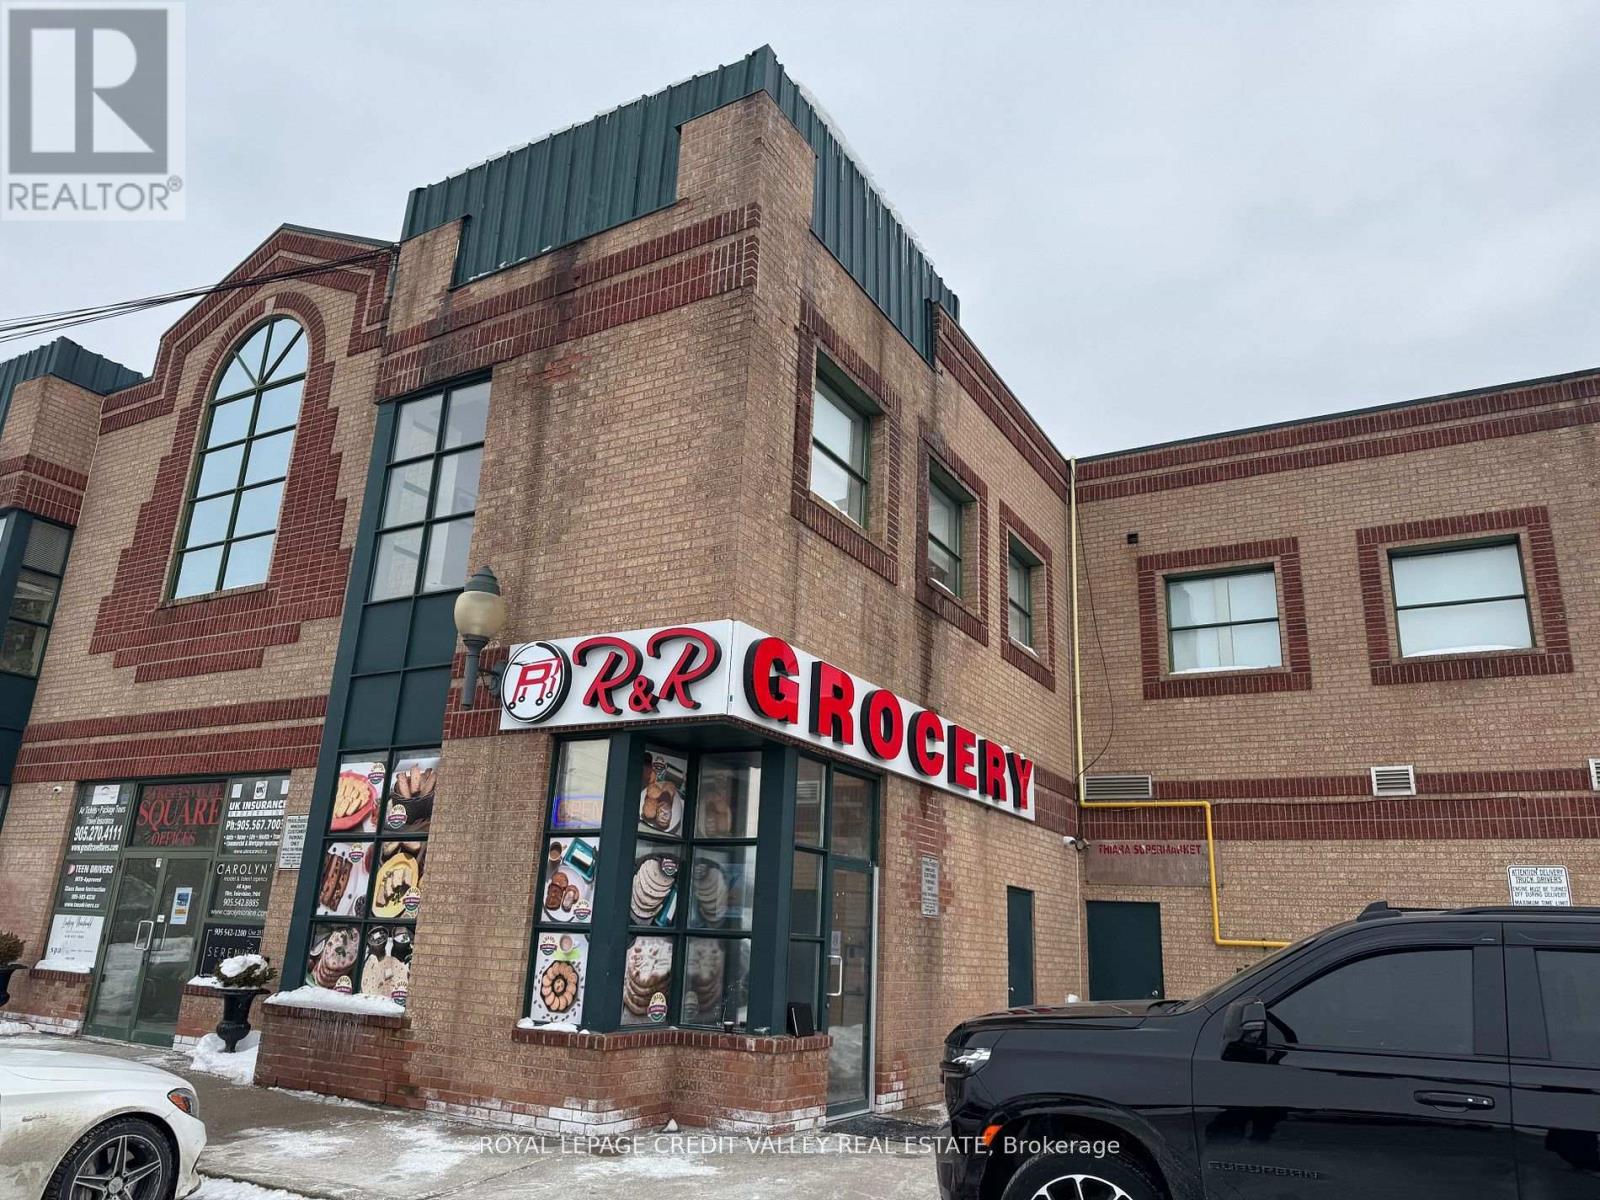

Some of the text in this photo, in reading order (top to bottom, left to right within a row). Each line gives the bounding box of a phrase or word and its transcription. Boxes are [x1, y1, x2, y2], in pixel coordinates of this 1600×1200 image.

[572, 628, 723, 716] R&R
[743, 636, 1033, 811] GROCERY
[73, 824, 123, 842] 905.270.4111
[137, 798, 224, 832] SQUARE
